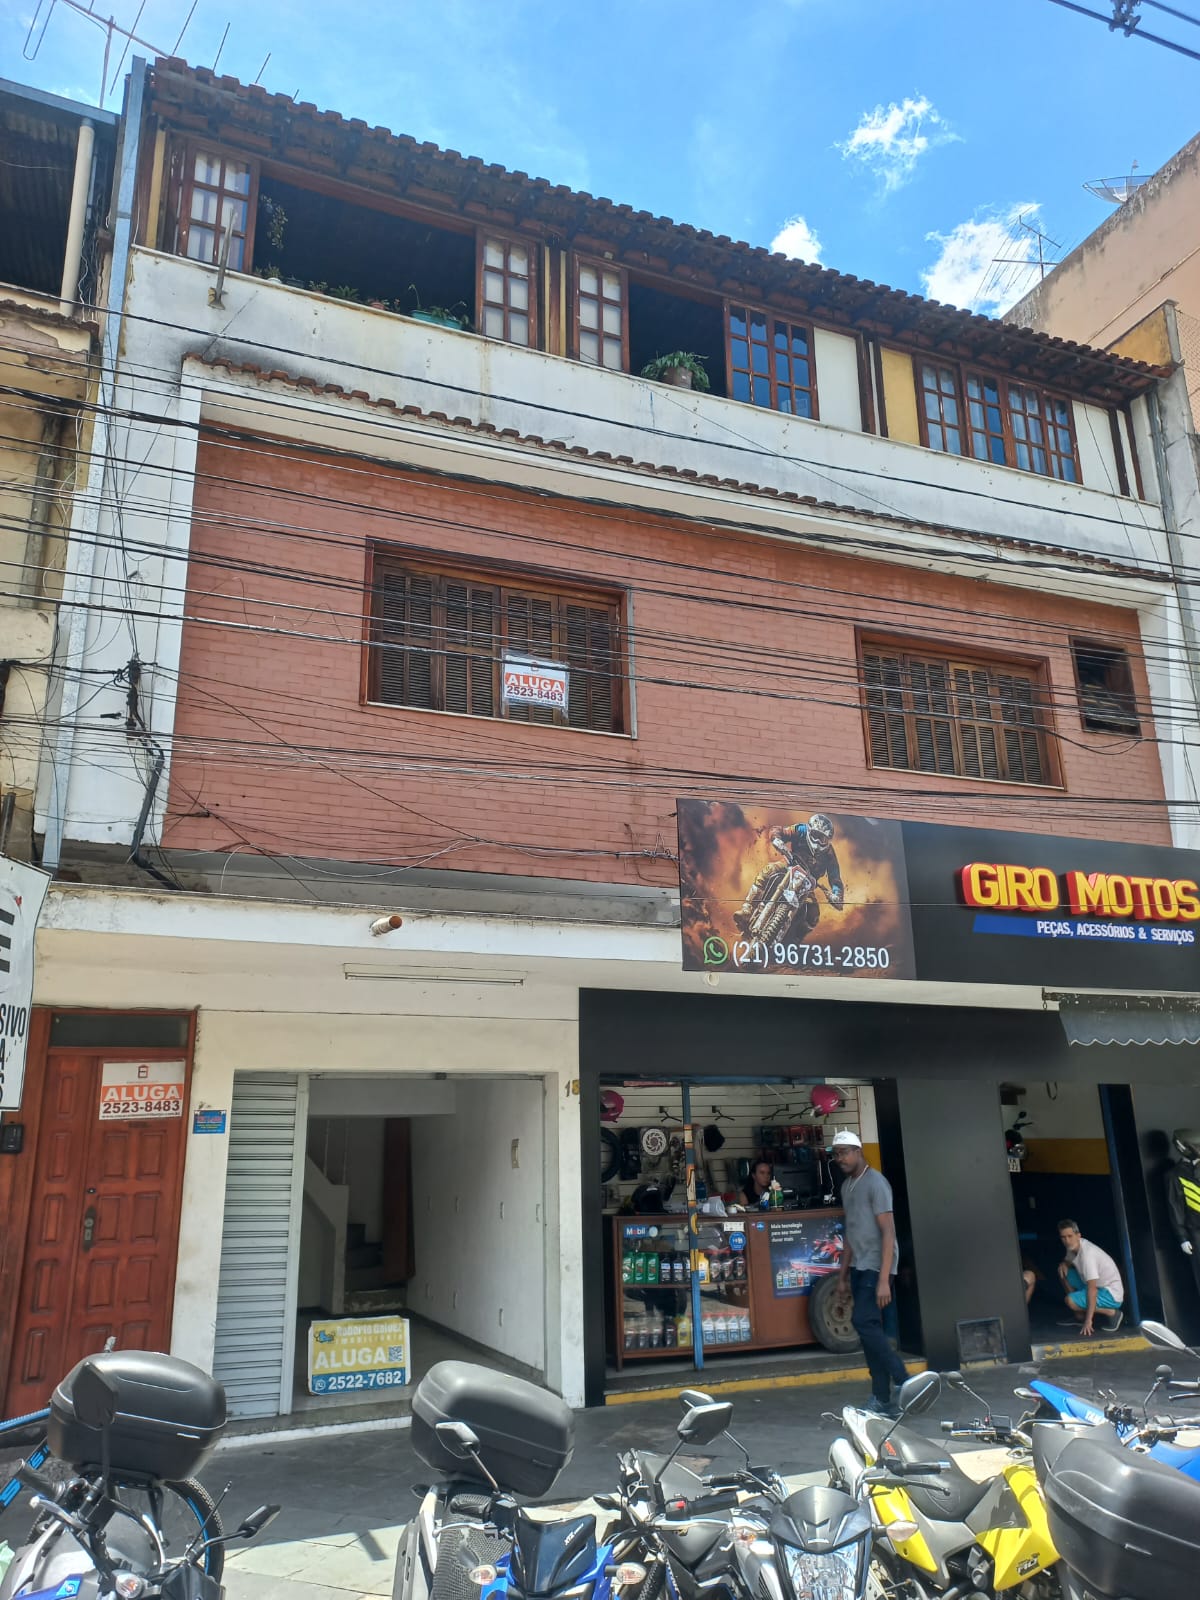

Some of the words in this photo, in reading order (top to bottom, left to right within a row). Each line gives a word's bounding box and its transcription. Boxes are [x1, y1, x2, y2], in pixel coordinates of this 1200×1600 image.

[506, 685, 563, 702] 2523-8483
[507, 674, 563, 693] ALUGA
[963, 862, 1059, 911] GIRO
[1066, 870, 1200, 921] MOTOS
[1036, 920, 1074, 938] PEÇAS,
[1076, 922, 1136, 940] ACESSÓRIOS
[1138, 928, 1148, 940] &
[1150, 928, 1195, 945] SERVIÇOS
[732, 941, 770, 968] (21)
[773, 943, 891, 969] 96731-2850
[103, 1085, 180, 1102] ALUGA
[102, 1100, 181, 1115] 2523-8483
[626, 1226, 646, 1235] Mobil
[314, 1346, 387, 1370] ALUGA
[328, 1370, 402, 1391] 2522-7682
